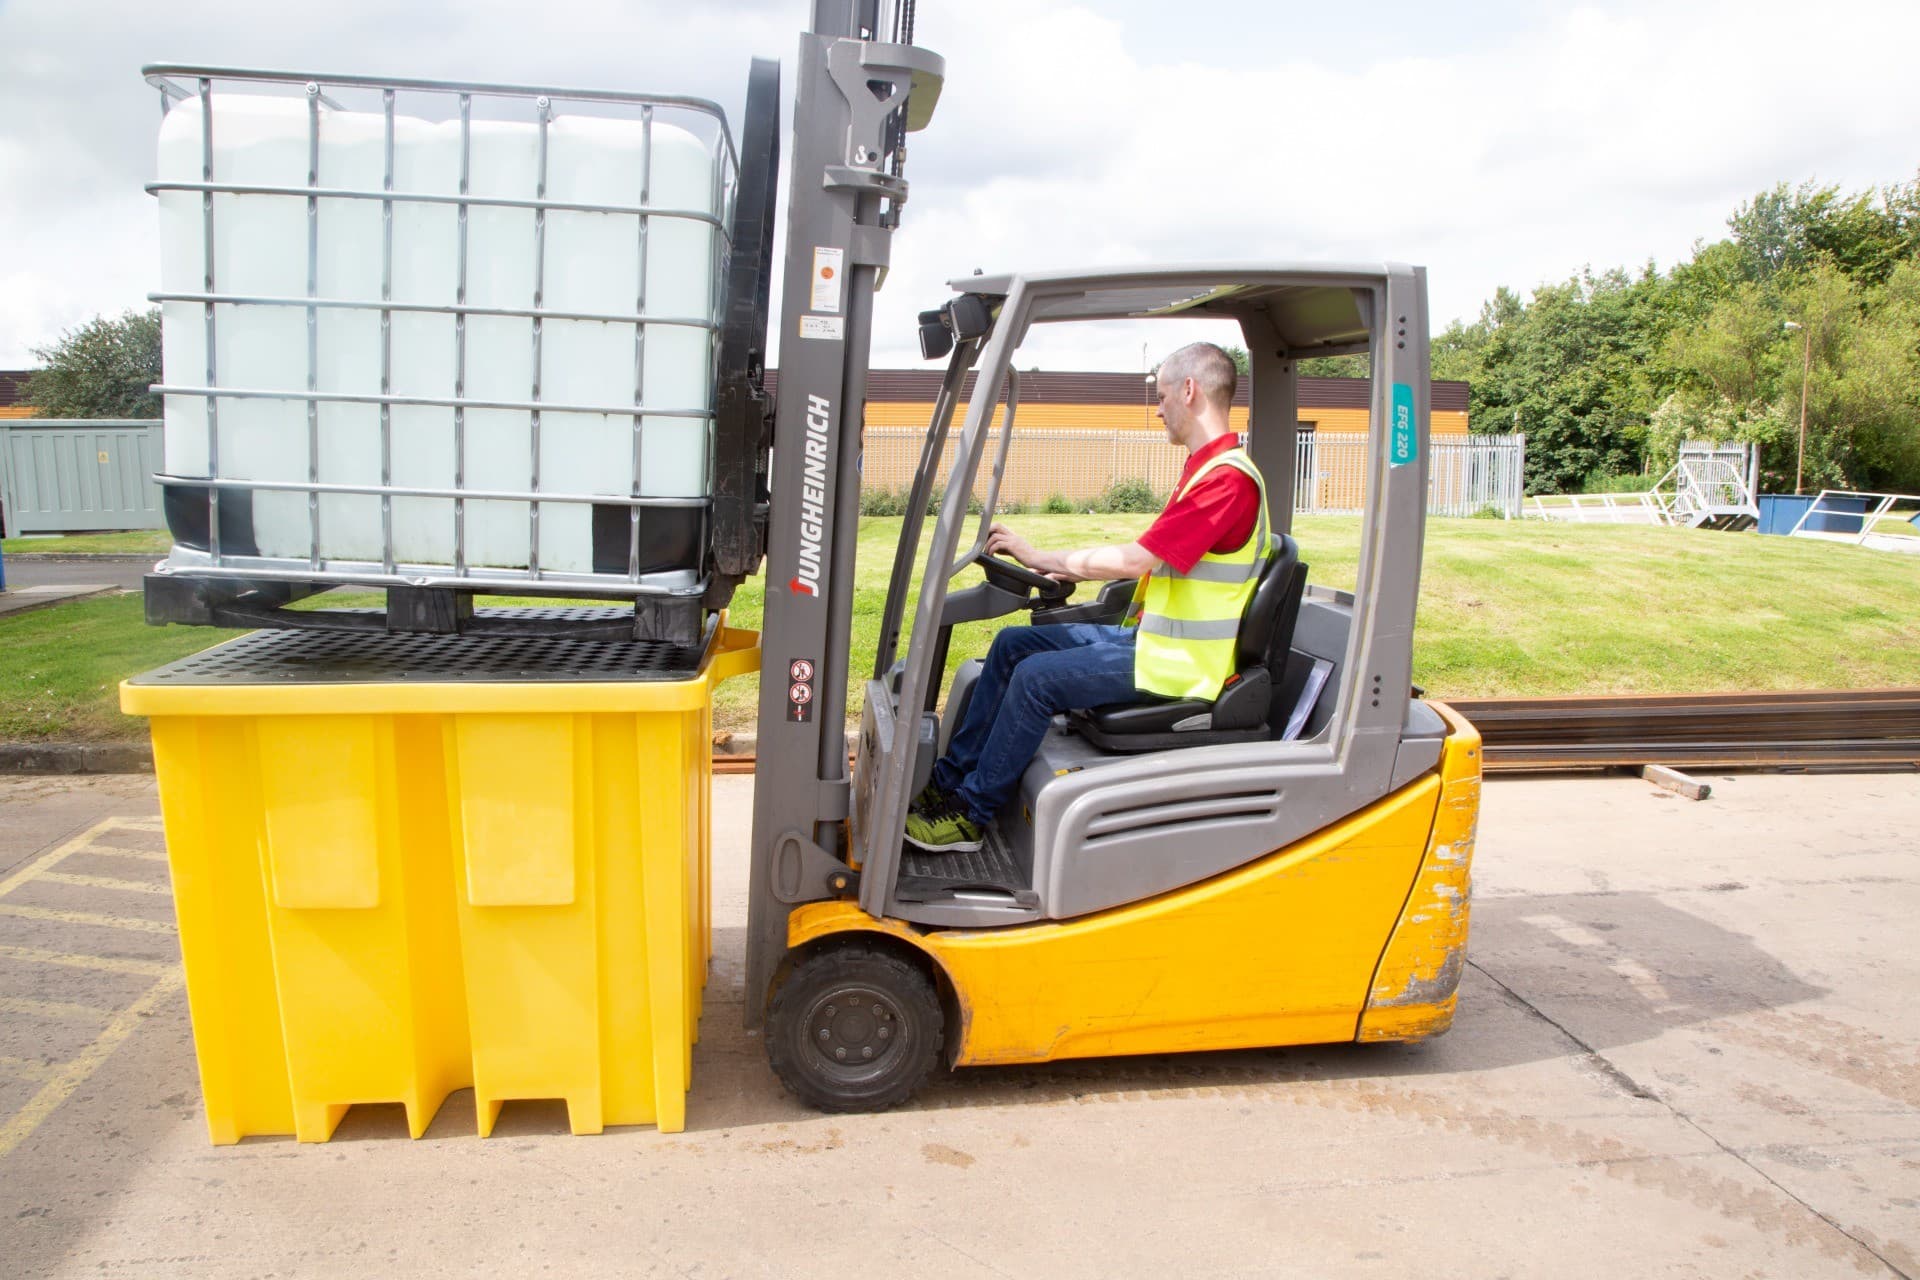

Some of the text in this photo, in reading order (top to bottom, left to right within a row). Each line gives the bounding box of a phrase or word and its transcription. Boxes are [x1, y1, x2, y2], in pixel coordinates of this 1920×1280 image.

[789, 393, 830, 598] JUNGHEINRICH
[1397, 404, 1408, 458] EFG 220
